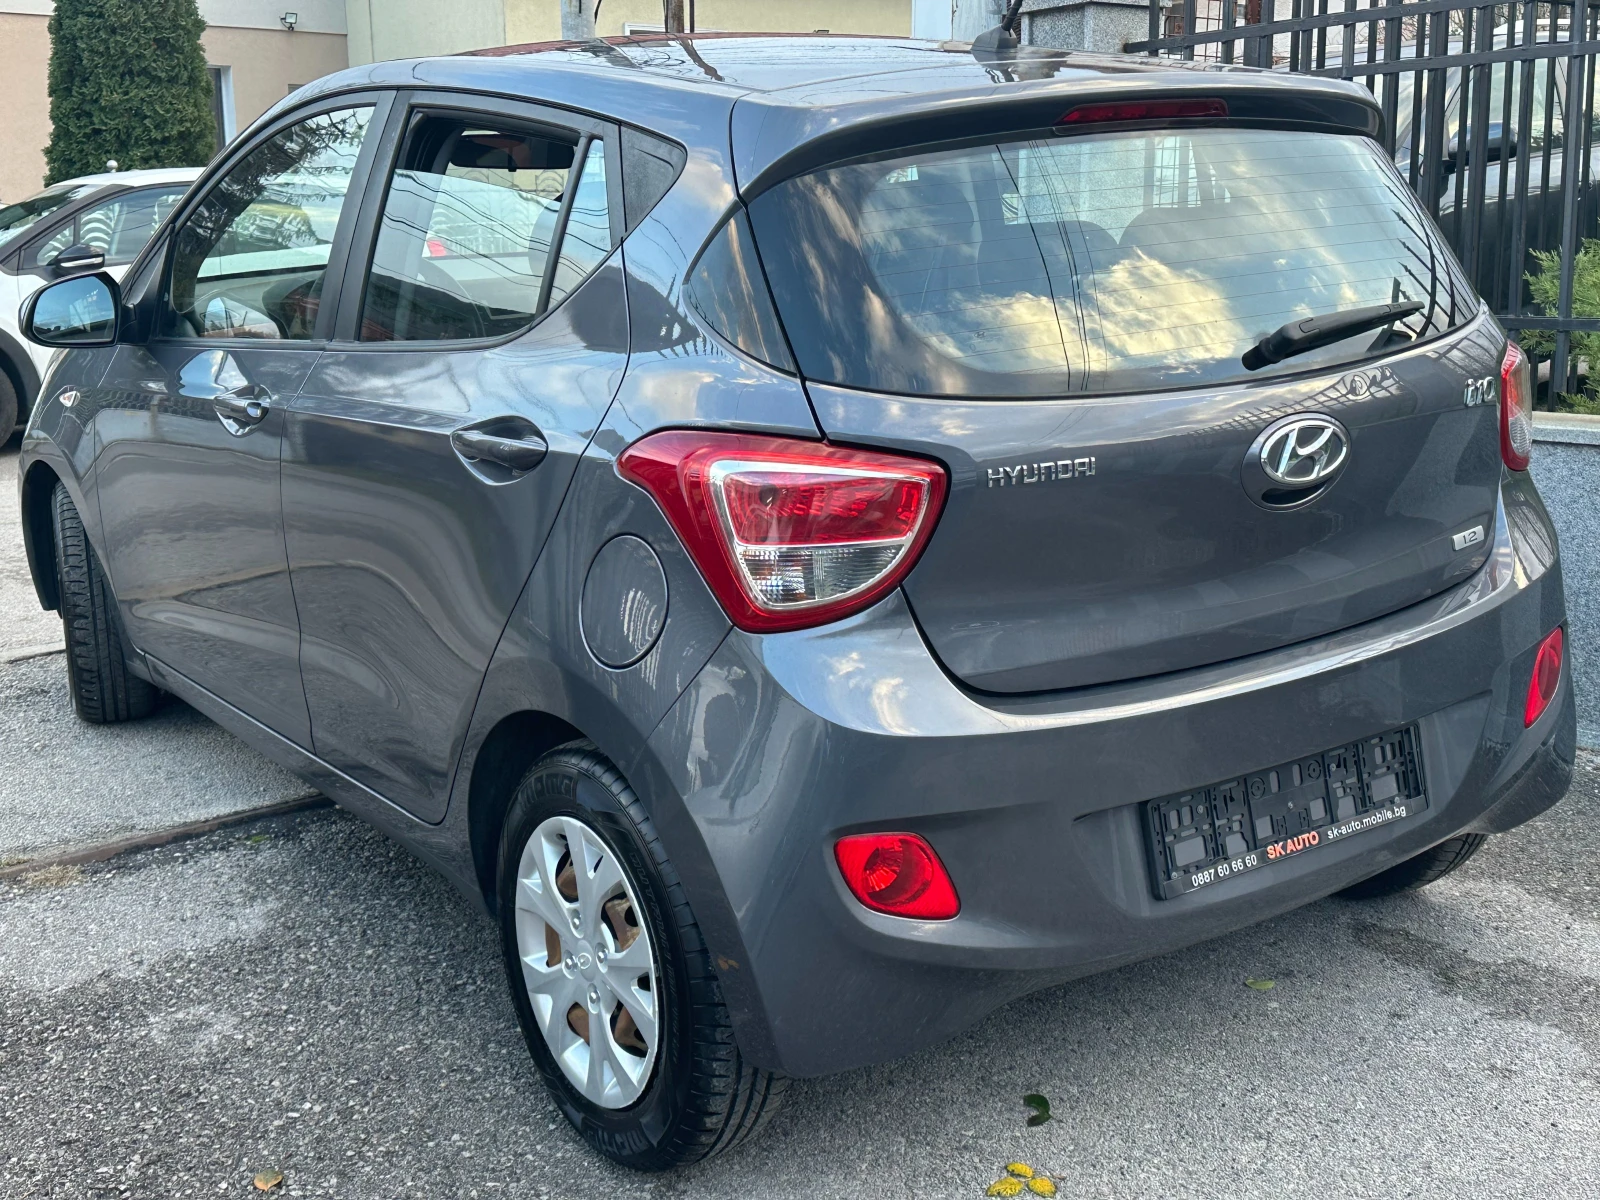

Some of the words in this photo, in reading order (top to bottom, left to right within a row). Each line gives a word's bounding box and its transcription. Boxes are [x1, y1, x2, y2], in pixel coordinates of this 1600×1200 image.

[1463, 376, 1496, 407] i10
[987, 456, 1096, 488] HYUNDAI
[1191, 868, 1215, 887] 0887
[1217, 863, 1230, 877] 60
[1231, 858, 1244, 872] 66
[1245, 854, 1258, 868] 60
[1266, 841, 1286, 859] SK
[1286, 830, 1320, 854] AUTO
[1327, 805, 1407, 839] sk-auto.mobile.bg
